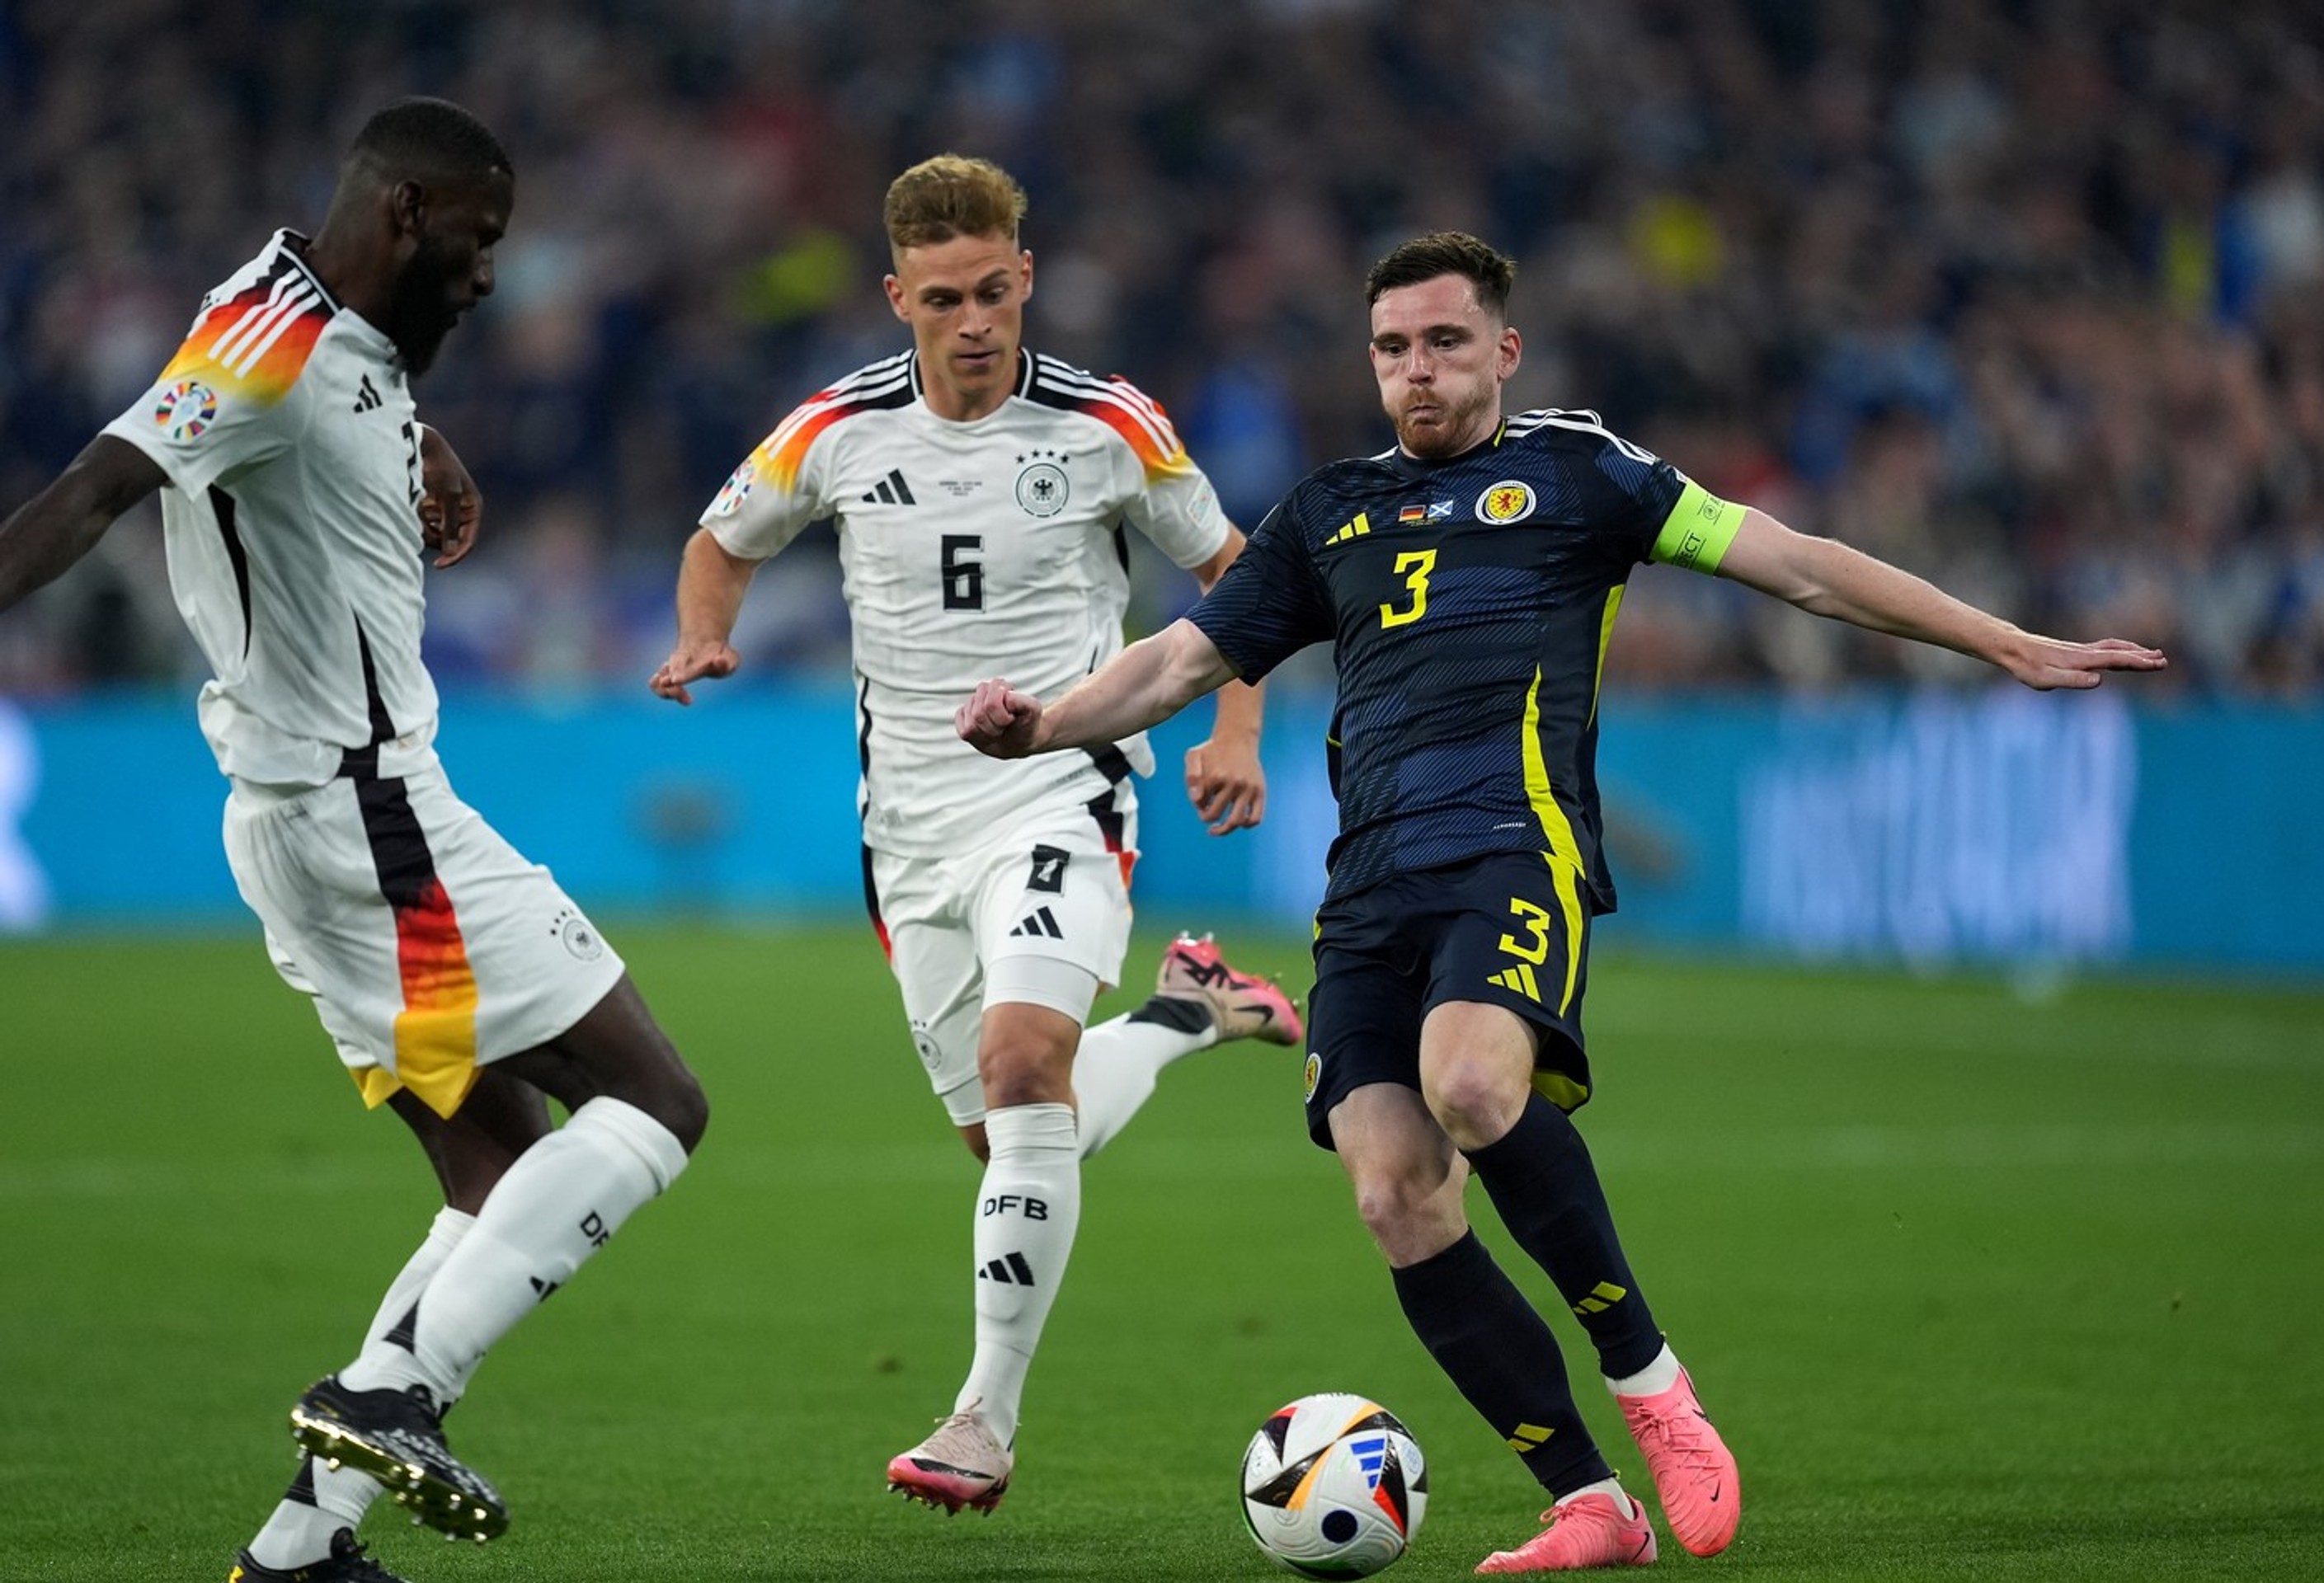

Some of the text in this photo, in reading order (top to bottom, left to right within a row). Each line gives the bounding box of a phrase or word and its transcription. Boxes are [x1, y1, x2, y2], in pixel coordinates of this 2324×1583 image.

[941, 534, 986, 614] 6
[1380, 548, 1437, 629] 3
[1498, 897, 1550, 965] 3
[985, 1195, 1048, 1221] DFB
